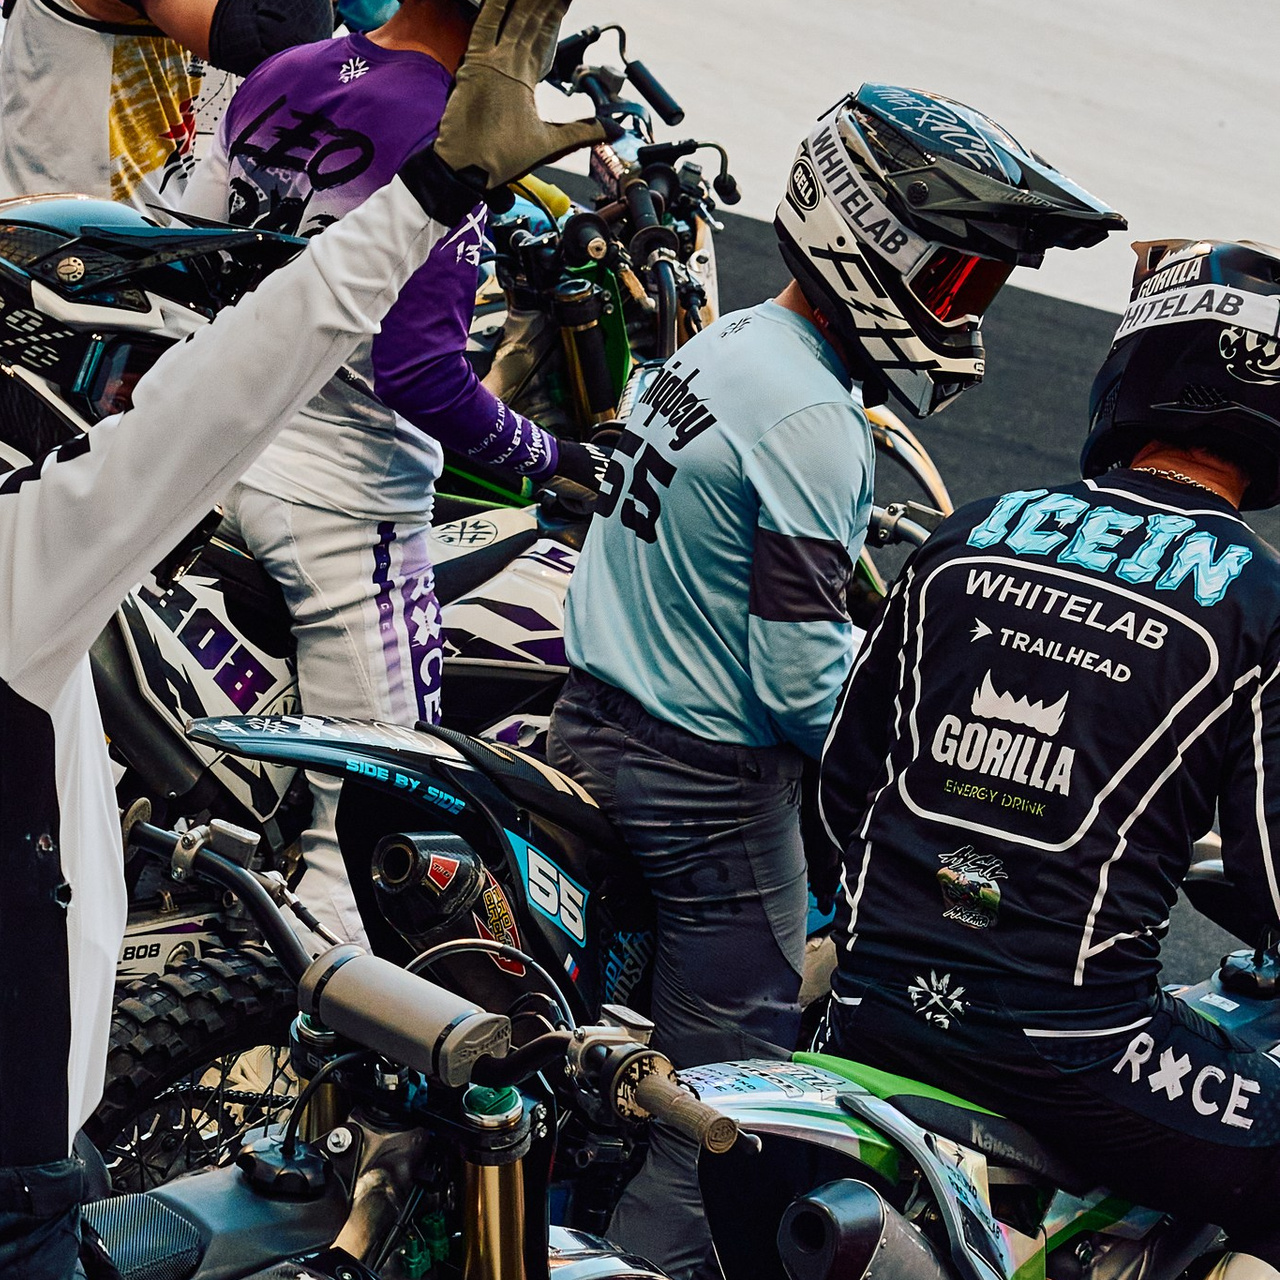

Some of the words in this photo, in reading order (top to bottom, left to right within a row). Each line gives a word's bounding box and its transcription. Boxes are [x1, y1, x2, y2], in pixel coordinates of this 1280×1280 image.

[793, 166, 814, 206] BELL
[811, 125, 909, 255] WHITELAB
[1138, 257, 1204, 299] GORILLA
[1119, 288, 1245, 334] HITELAB
[965, 487, 1253, 608] ICEIN
[965, 568, 1170, 651] WHITELAB
[999, 627, 1133, 684] TRAILHEAD
[930, 713, 1077, 798] GORILLA
[344, 757, 391, 783] SIDE
[393, 772, 422, 794] BY
[426, 783, 467, 817] SIDE
[943, 778, 1000, 804] ENERGY
[1000, 792, 1048, 818] DRINK
[526, 845, 586, 942] 55
[122, 942, 162, 961] 808
